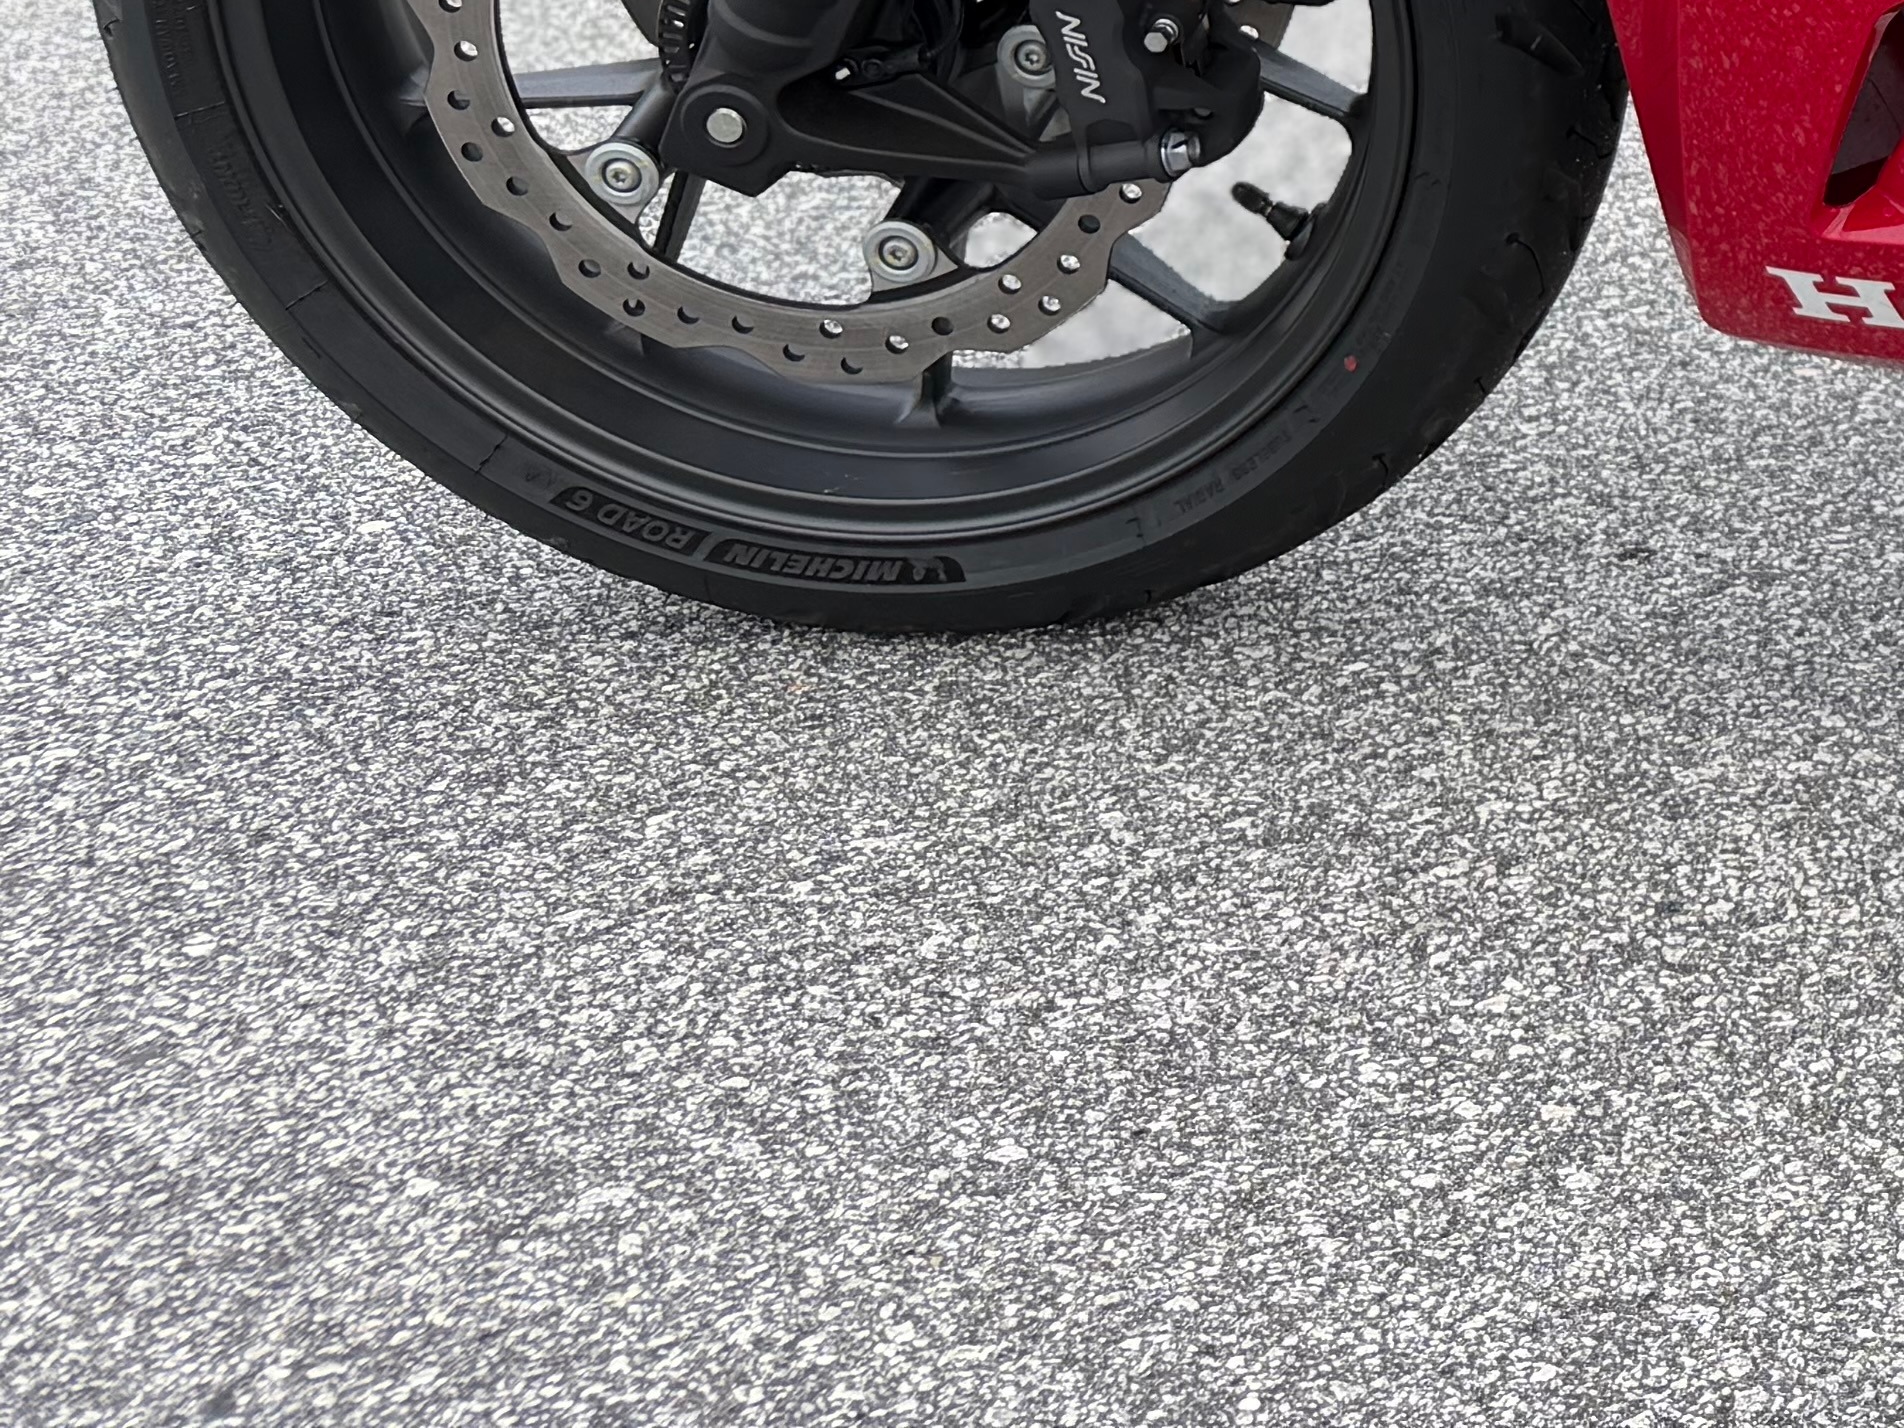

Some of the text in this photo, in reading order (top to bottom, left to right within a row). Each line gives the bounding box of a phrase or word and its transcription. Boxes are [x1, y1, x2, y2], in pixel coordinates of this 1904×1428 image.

[564, 486, 904, 583] MICHELIN ROAD 6
